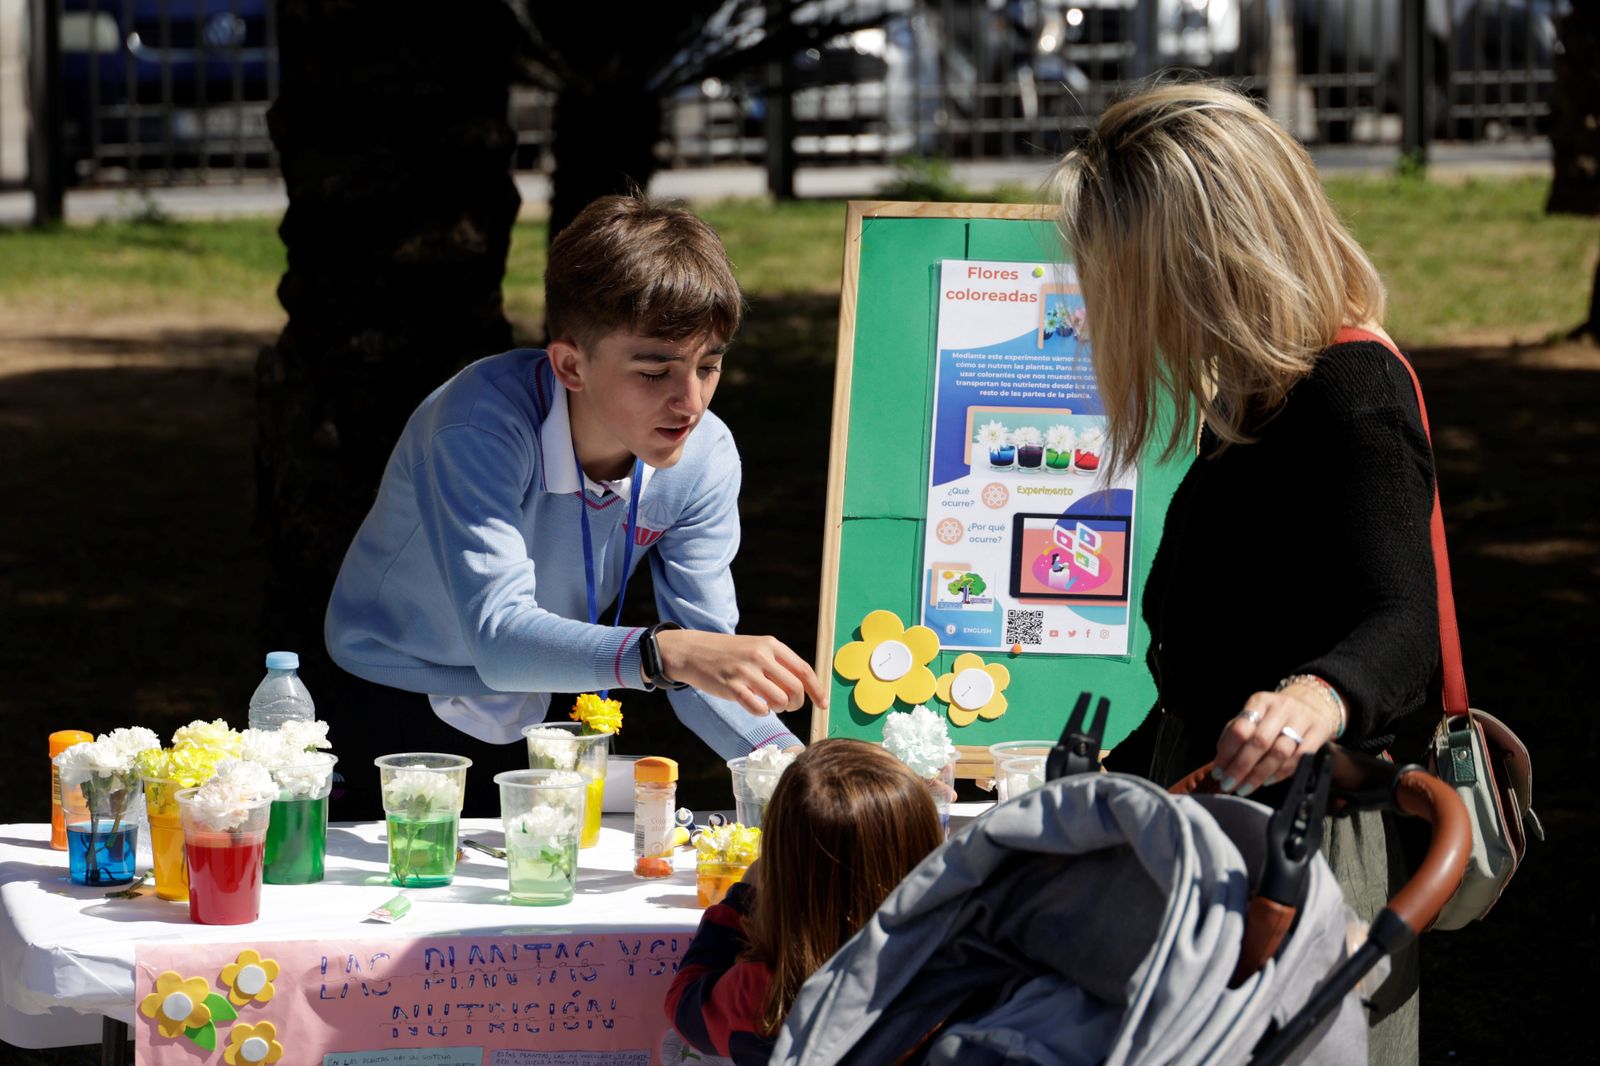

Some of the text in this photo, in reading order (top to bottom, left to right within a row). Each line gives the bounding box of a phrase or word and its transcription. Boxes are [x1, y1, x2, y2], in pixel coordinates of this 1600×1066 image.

[967, 266, 1019, 280] Flores
[945, 288, 1038, 303] coloreadas
[952, 352, 986, 360] Mediante
[1004, 354, 1051, 362] experimento
[956, 379, 999, 388] transportan
[1012, 381, 1050, 389] nutrientes
[947, 486, 970, 497] ¿Qué
[1016, 485, 1074, 496] Experimento
[941, 499, 975, 508] ocurre?
[967, 522, 1006, 533] ¿Por qué
[968, 536, 1003, 545] ocurre?
[963, 626, 992, 635] ENGLISH
[319, 952, 392, 1000] LAS
[423, 940, 598, 991] PLANTAS
